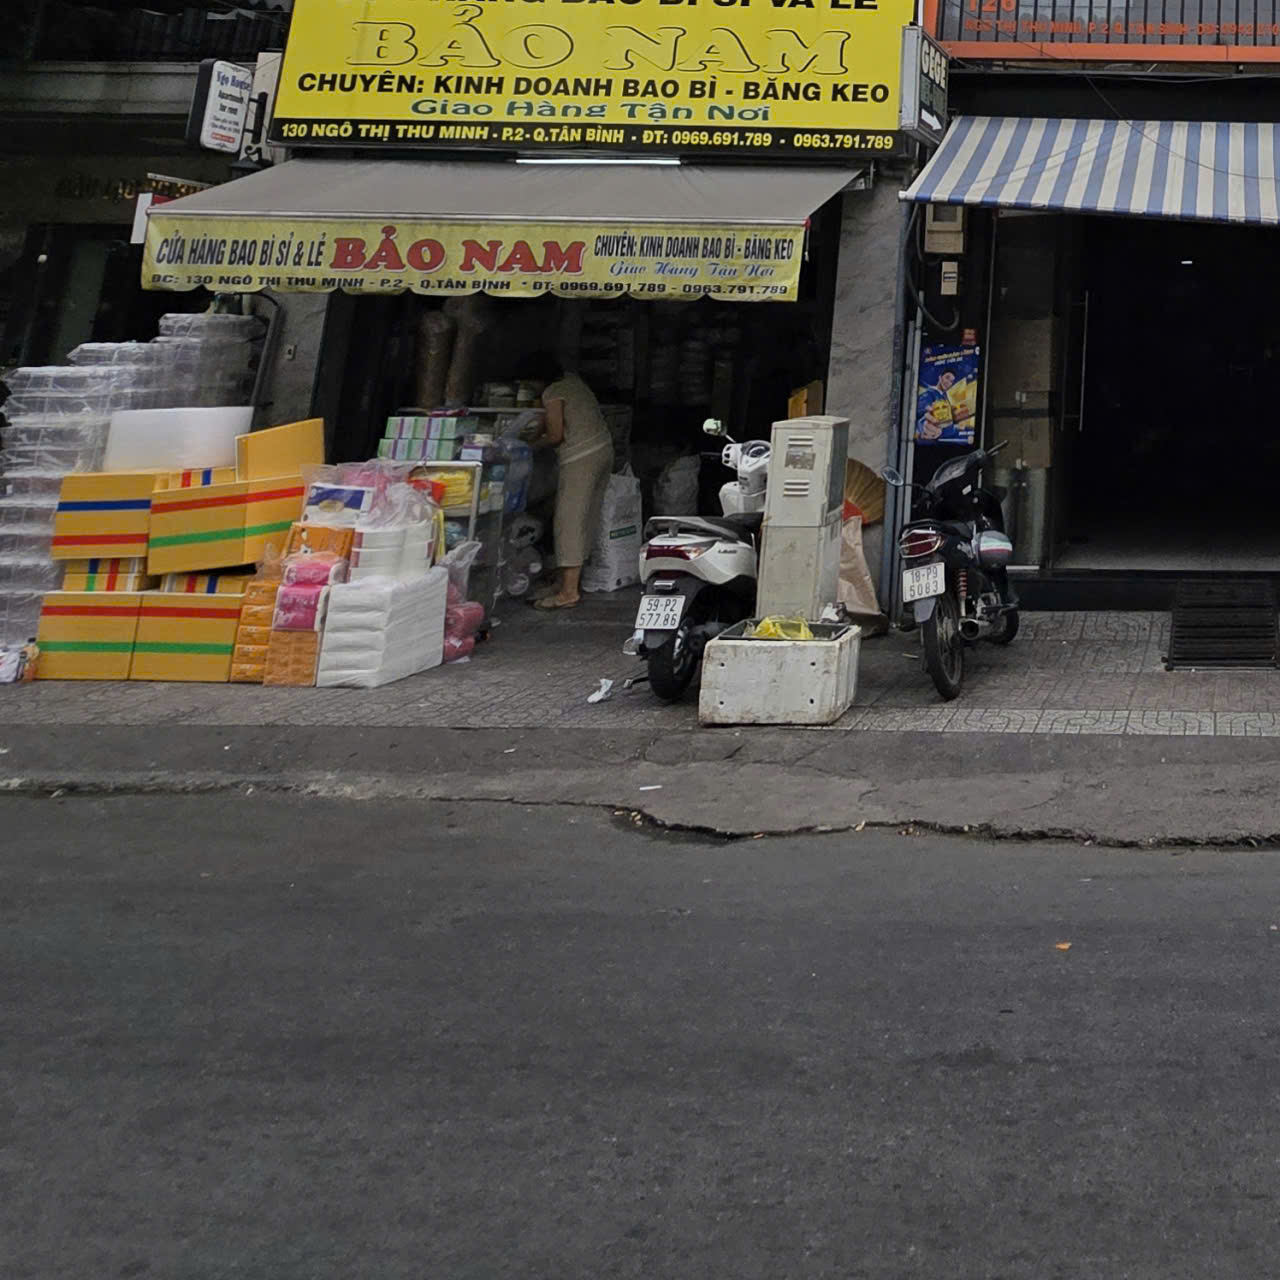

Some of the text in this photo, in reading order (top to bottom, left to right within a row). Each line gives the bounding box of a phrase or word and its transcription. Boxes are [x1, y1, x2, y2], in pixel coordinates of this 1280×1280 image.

[344, 3, 853, 76] BẢO NAM
[297, 70, 890, 104] CHUYÊN: KINH DOANH BAO BÌ BĂNG KEO
[410, 98, 772, 123] Giao Hàng Tận Nơi
[281, 123, 308, 138] 130
[310, 121, 353, 138] NGÔ
[358, 124, 391, 142] THỊ
[395, 124, 435, 140] THU
[438, 125, 490, 141] MINH
[532, 124, 582, 143] Q.TÂN
[585, 125, 625, 144] BÌNH
[641, 130, 670, 145] ĐT:
[671, 130, 773, 147] 0969.691.789
[792, 133, 895, 150] 0963.791.789
[156, 229, 327, 268] CỬA HÀNG BAO BÌ SỈ & LẺ
[329, 224, 587, 276] BẢO NAM
[594, 231, 795, 261] CHUYÊN: KINH DOANH BAO BÌ BĂNG KEO
[186, 274, 213, 285] 130
[217, 273, 254, 287] NGÔ
[257, 275, 281, 288] THỊ
[286, 276, 317, 287] THU
[321, 277, 365, 289] MINH
[379, 278, 403, 288] P.2
[471, 277, 512, 291] BÌNH
[559, 280, 667, 294] 0969.691.789
[682, 283, 789, 296] 0963.791.789
[910, 566, 938, 584] 18-P9
[909, 580, 938, 598] 5083
[645, 598, 678, 613] 59-P2
[638, 613, 678, 627] 577.86
